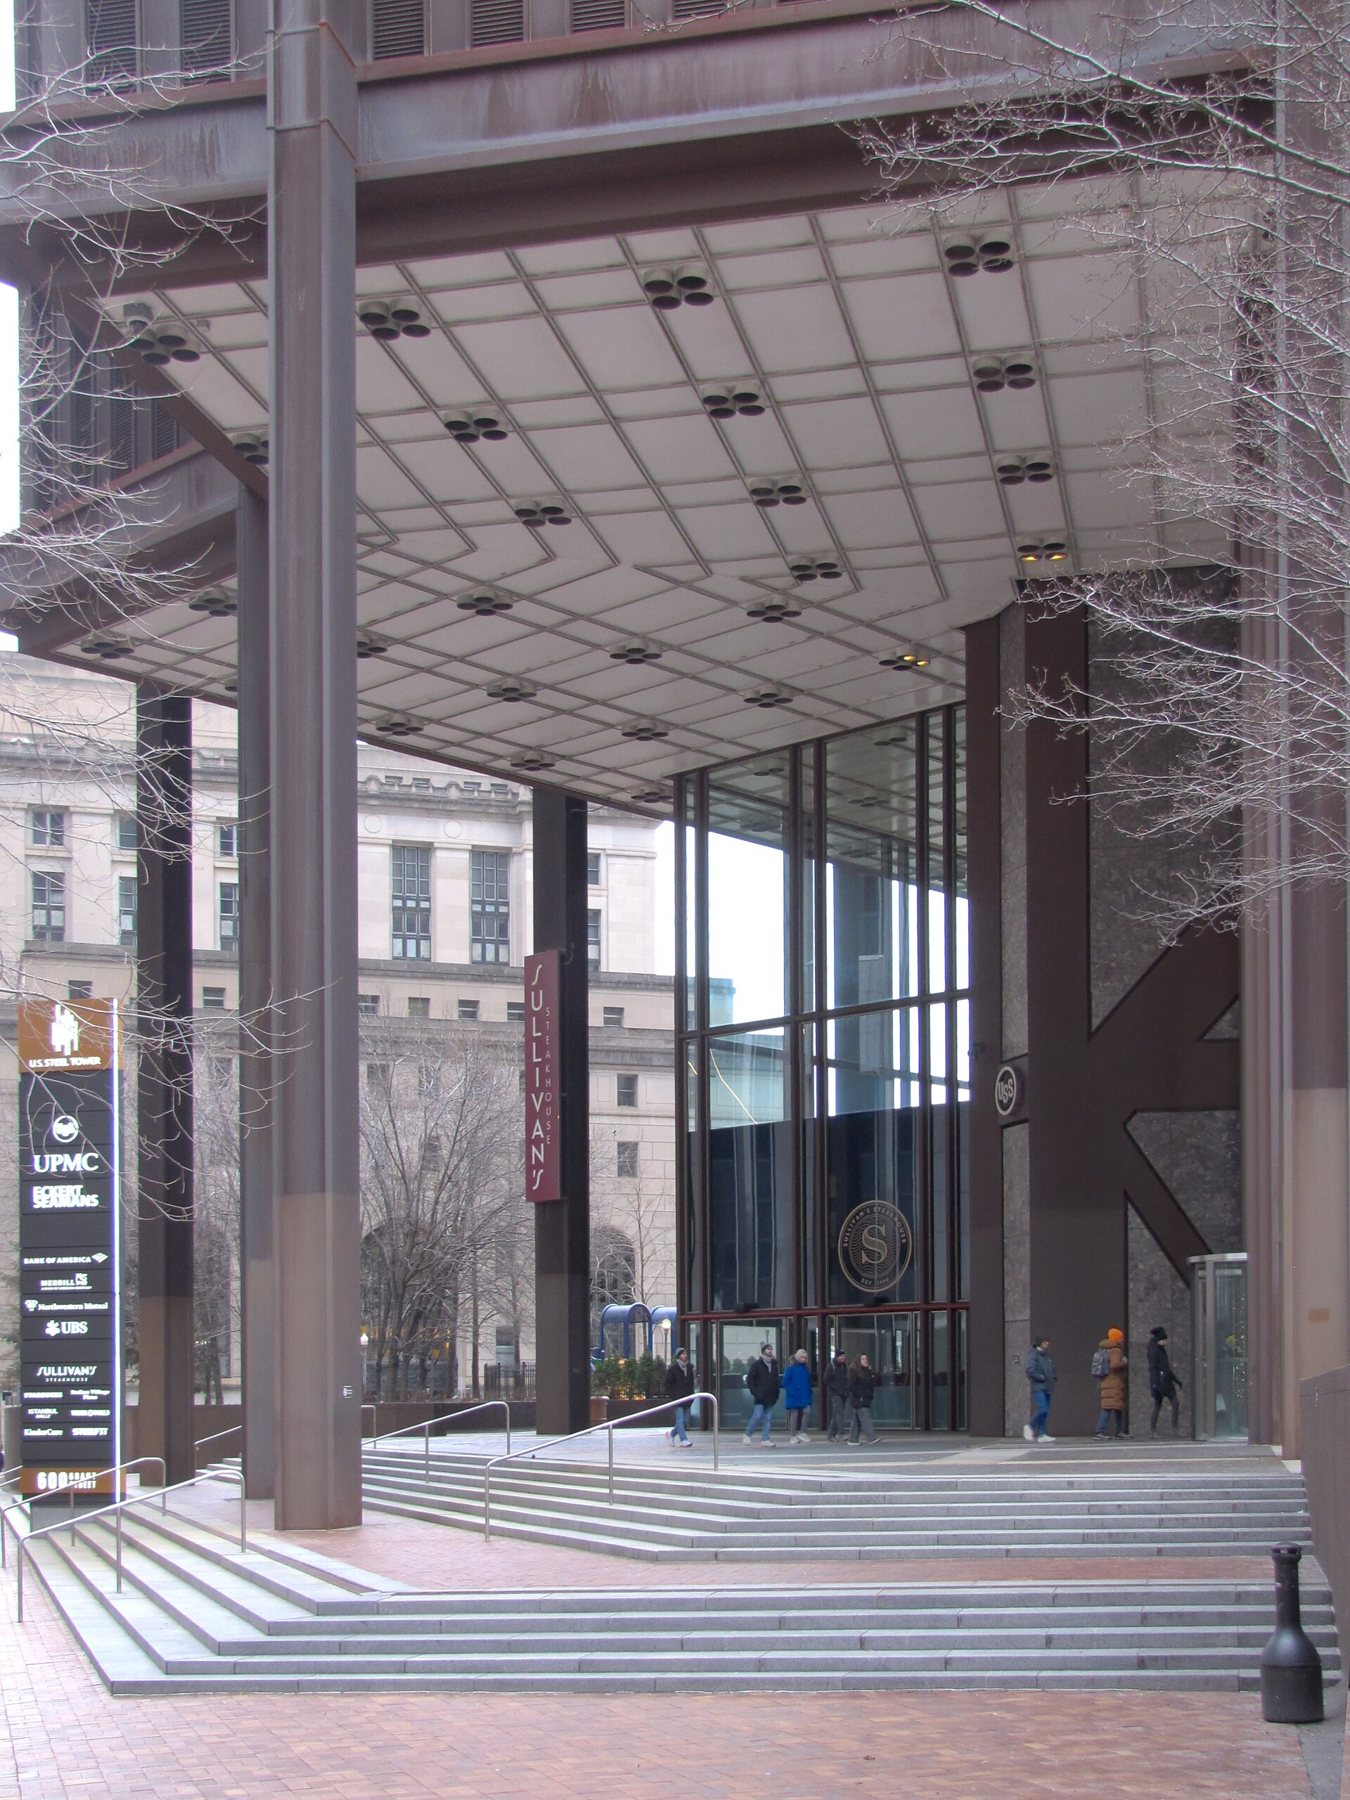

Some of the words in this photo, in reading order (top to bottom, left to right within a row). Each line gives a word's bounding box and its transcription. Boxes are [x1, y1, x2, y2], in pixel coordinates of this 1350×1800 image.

[44, 1058, 69, 1067] STEEL
[69, 1056, 101, 1066] TOWER
[531, 964, 544, 1190] SULLIVAN'S
[544, 1007, 552, 1145] STEAKHOUSE
[998, 1078, 1014, 1104] USS
[33, 1152, 99, 1173] UPMC
[33, 1185, 83, 1196] ECKERT
[33, 1195, 99, 1209] SEAMANS
[862, 1224, 888, 1264] S
[38, 1302, 84, 1310] Northwestern
[61, 1321, 88, 1334] UBS
[36, 1366, 97, 1376] SULLIVAN'S
[37, 1472, 68, 1489] 600
